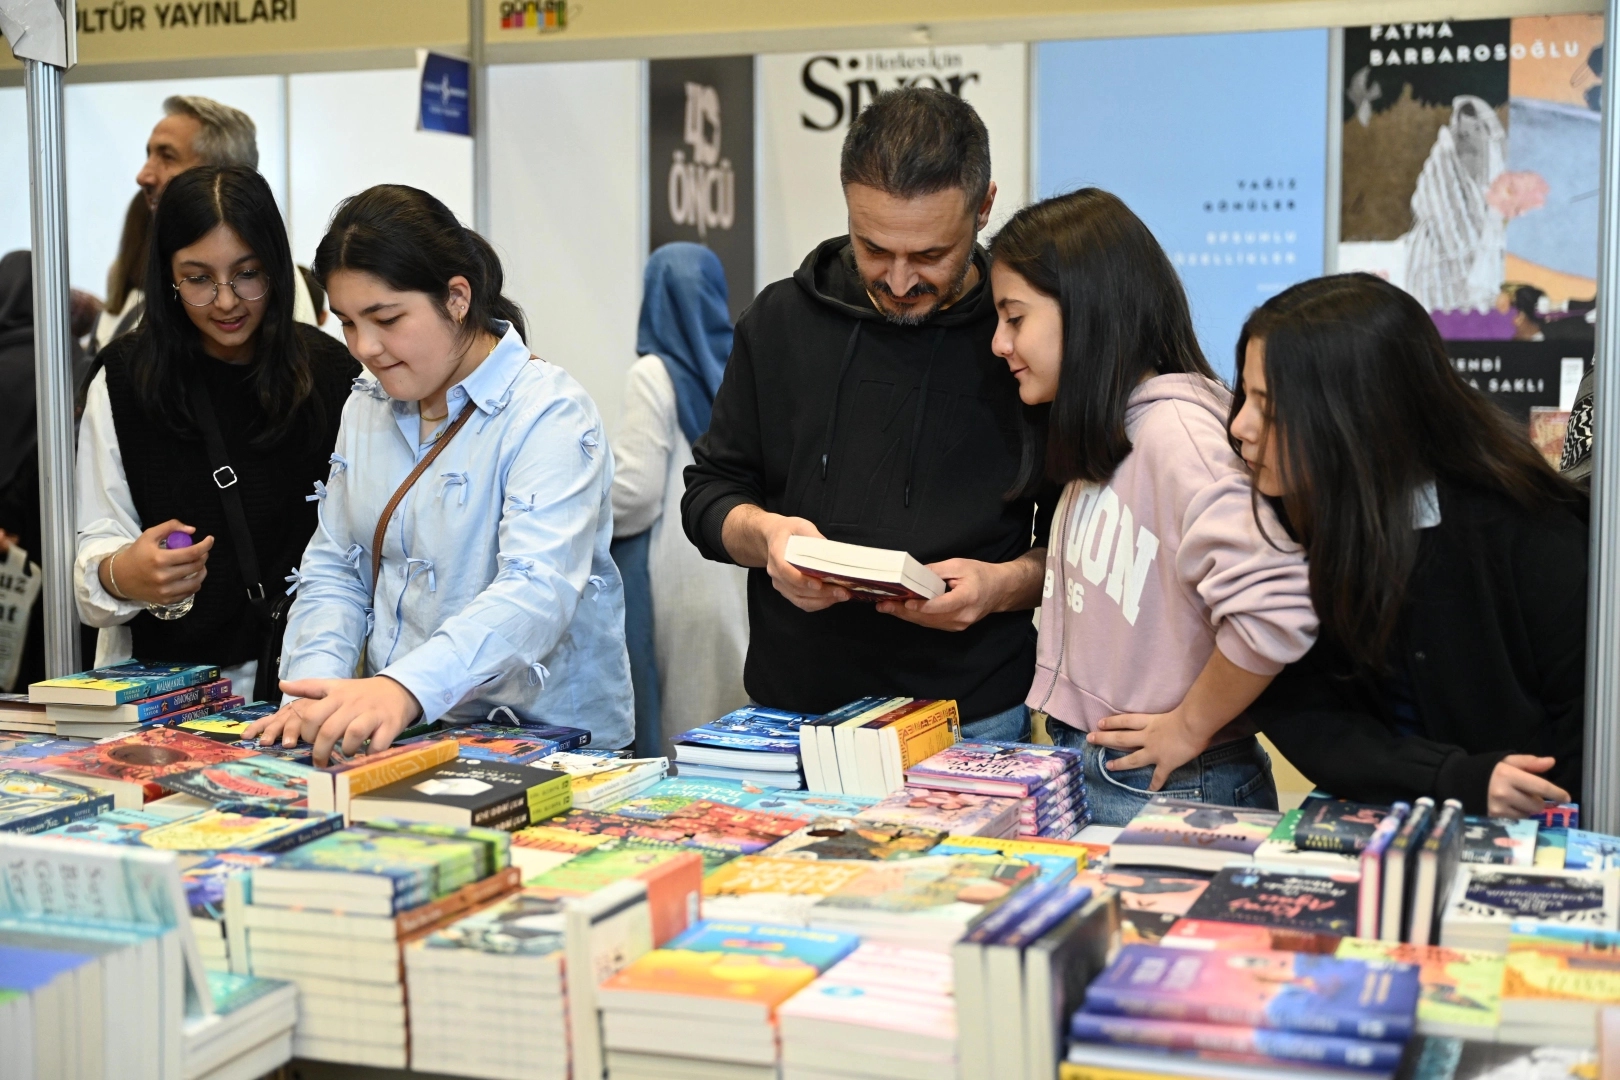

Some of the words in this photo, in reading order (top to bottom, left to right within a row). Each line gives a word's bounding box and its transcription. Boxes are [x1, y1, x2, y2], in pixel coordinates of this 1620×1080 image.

[1370, 21, 1453, 41] FATMA
[1369, 39, 1580, 66] BARBAROSOĞLU
[1450, 356, 1502, 373] ENDİ
[1488, 378, 1545, 393] SAKLI
